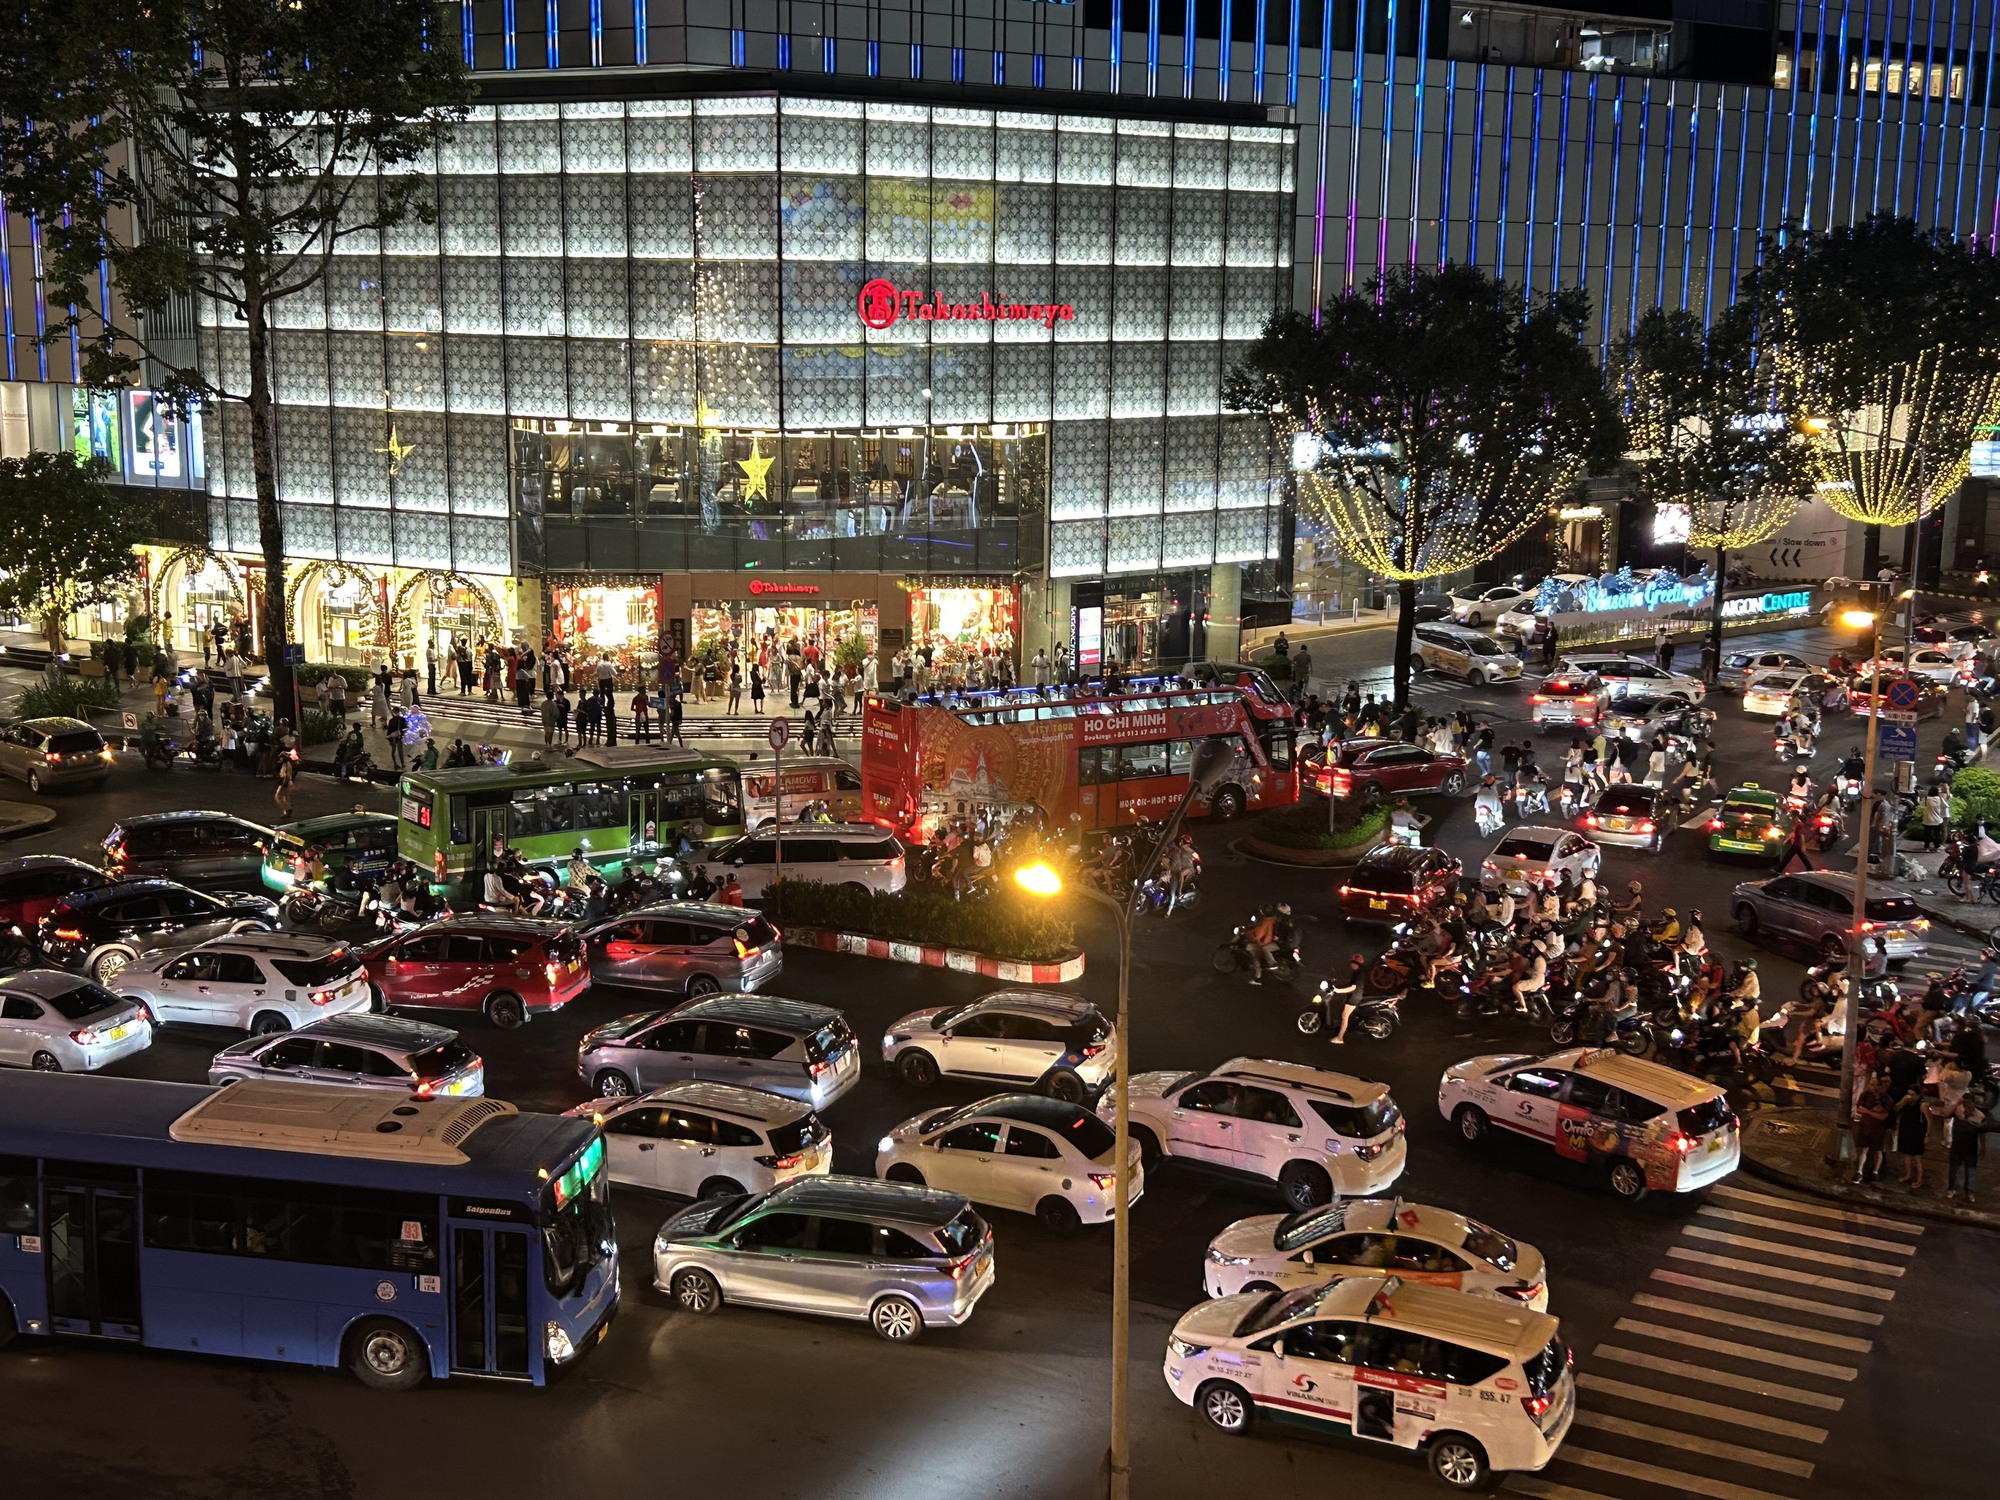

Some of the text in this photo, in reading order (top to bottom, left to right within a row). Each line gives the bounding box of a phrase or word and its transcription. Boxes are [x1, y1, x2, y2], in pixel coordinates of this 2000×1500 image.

[902, 291, 1074, 329] Takashimaya
[1783, 537, 1802, 546] Slow
[1804, 538, 1826, 547] down
[762, 582, 819, 594] Takashimaya
[1084, 712, 1166, 732] HO CHI MINH
[1120, 799, 1134, 809] HOP
[1168, 793, 1183, 803] OFF
[466, 1205, 512, 1216] SaigonBus
[403, 1222, 419, 1239] 93
